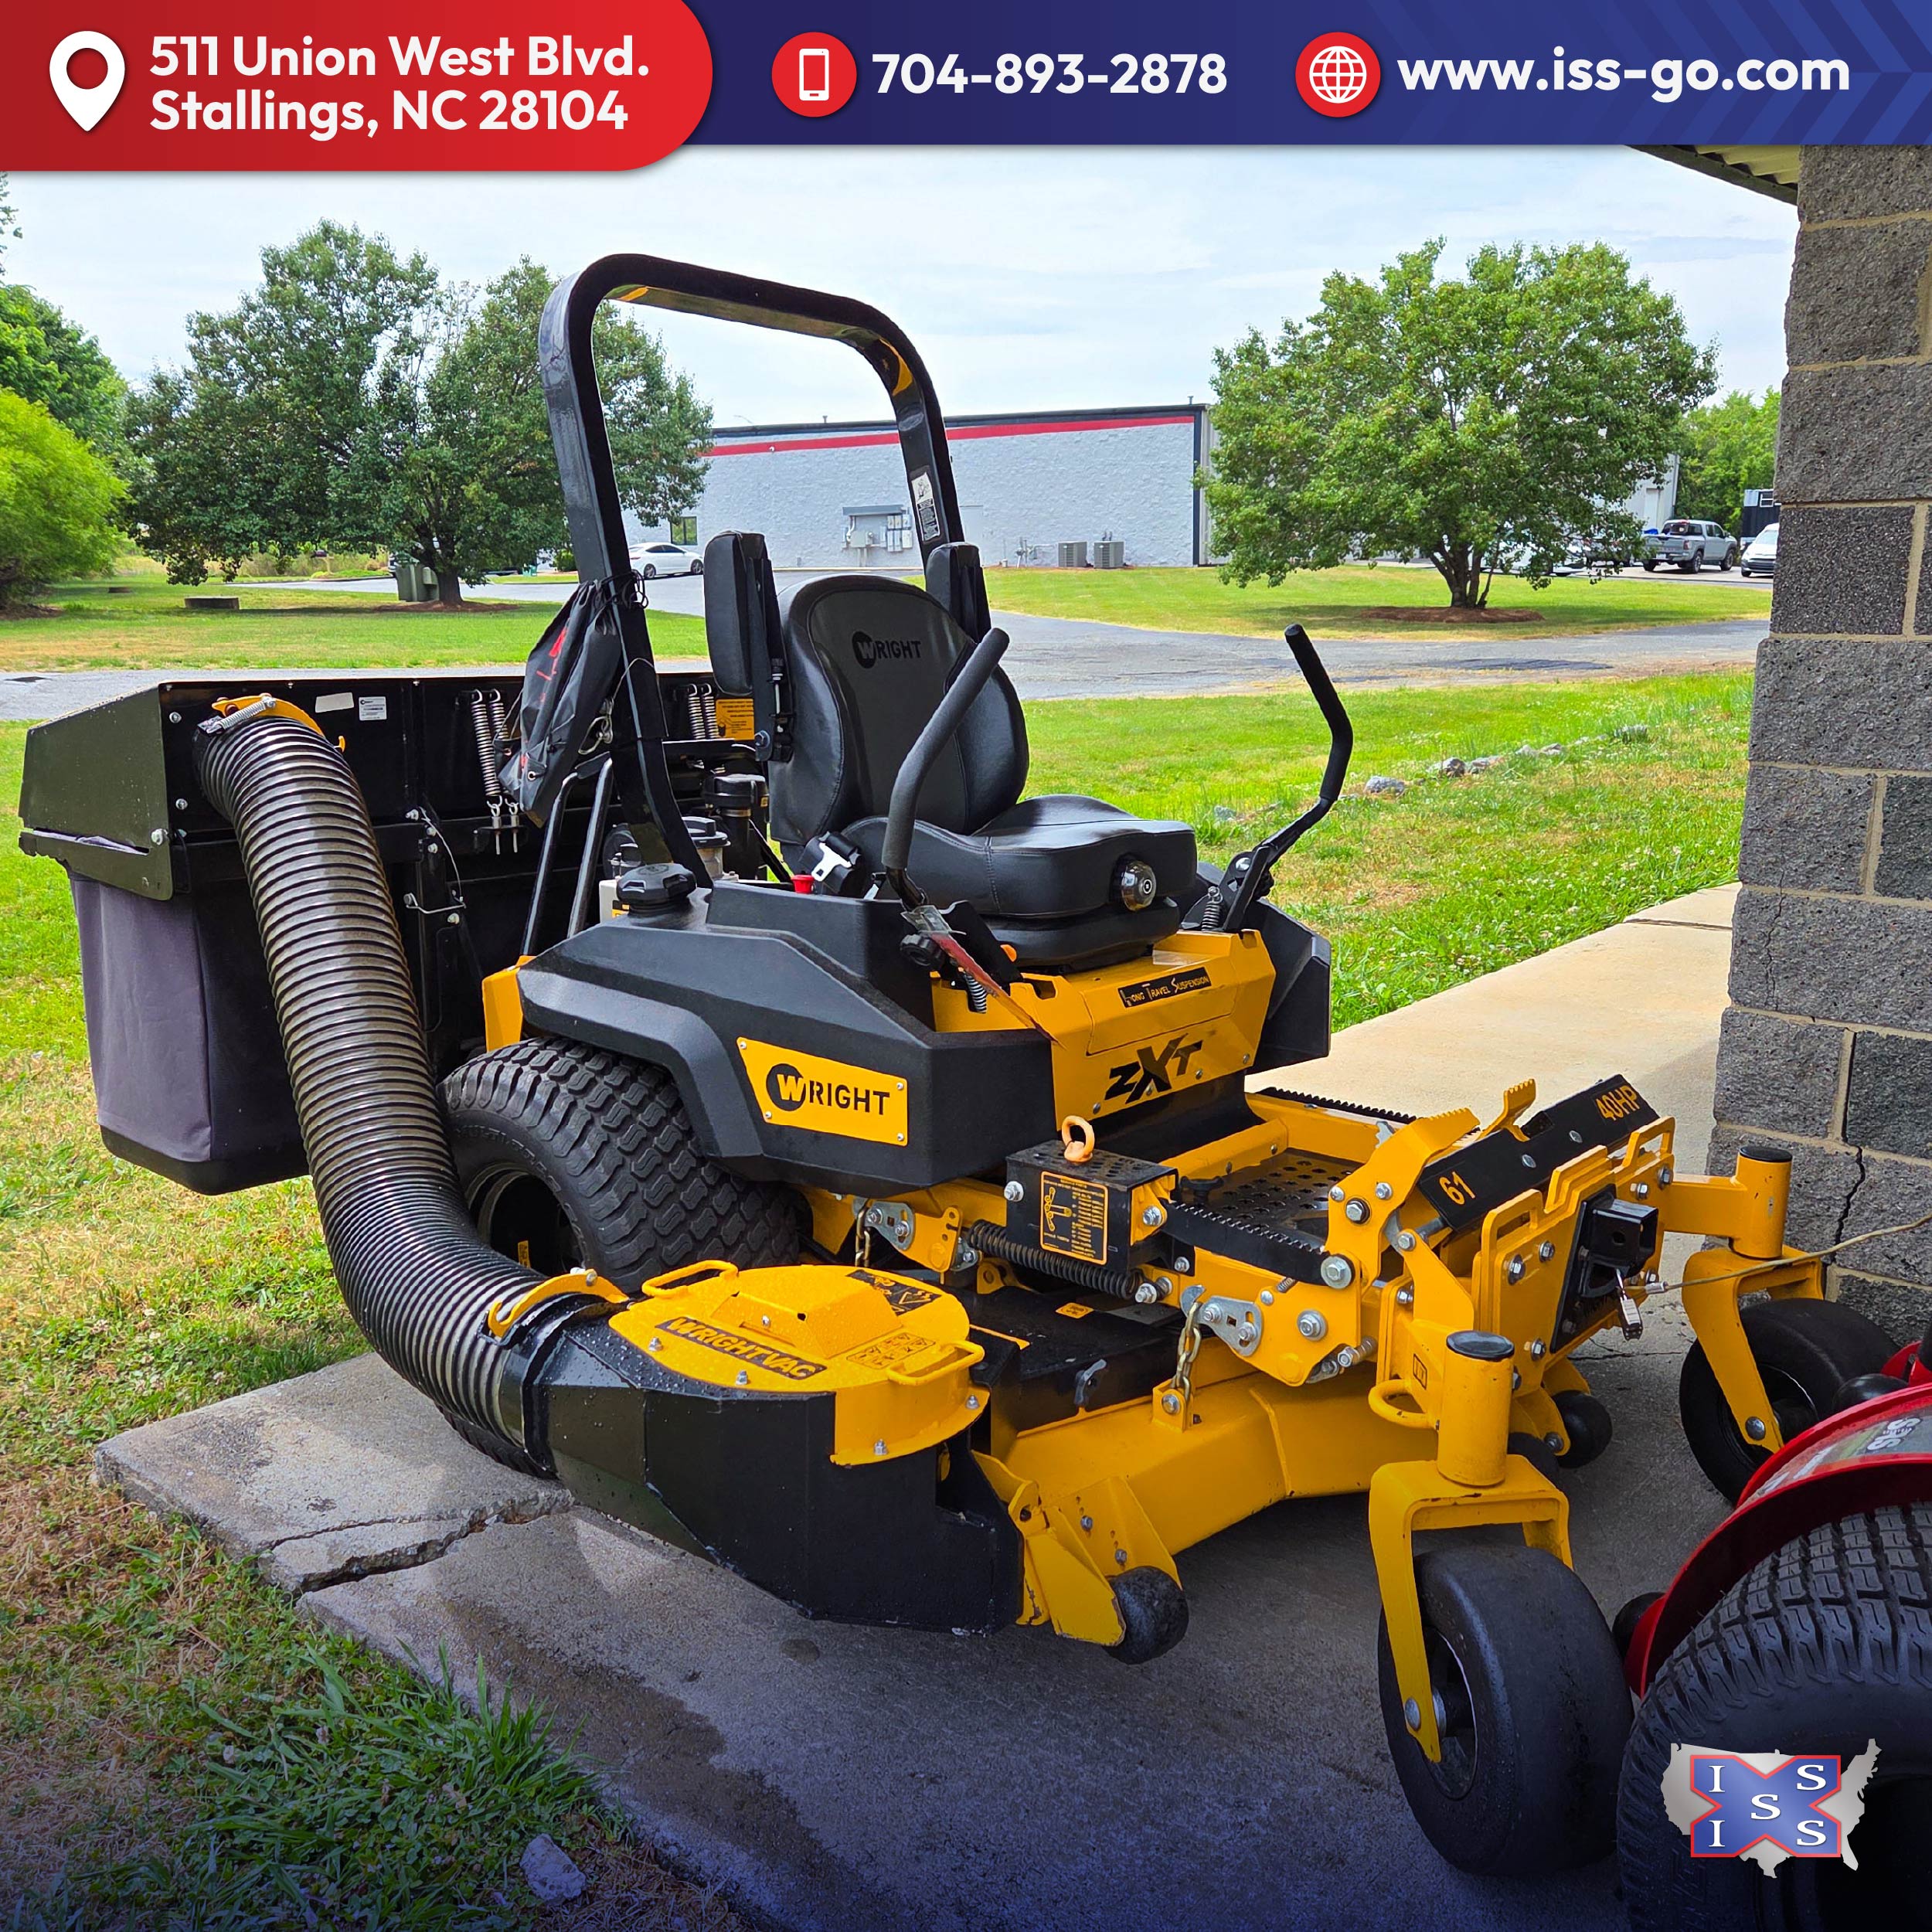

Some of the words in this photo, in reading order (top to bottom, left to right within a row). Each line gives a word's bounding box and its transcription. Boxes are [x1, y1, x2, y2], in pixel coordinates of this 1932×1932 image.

[852, 634, 922, 665] WRIGHT
[769, 1066, 890, 1115] WRIGHT
[1596, 1085, 1641, 1121] 40HP
[1439, 1172, 1476, 1206] 61
